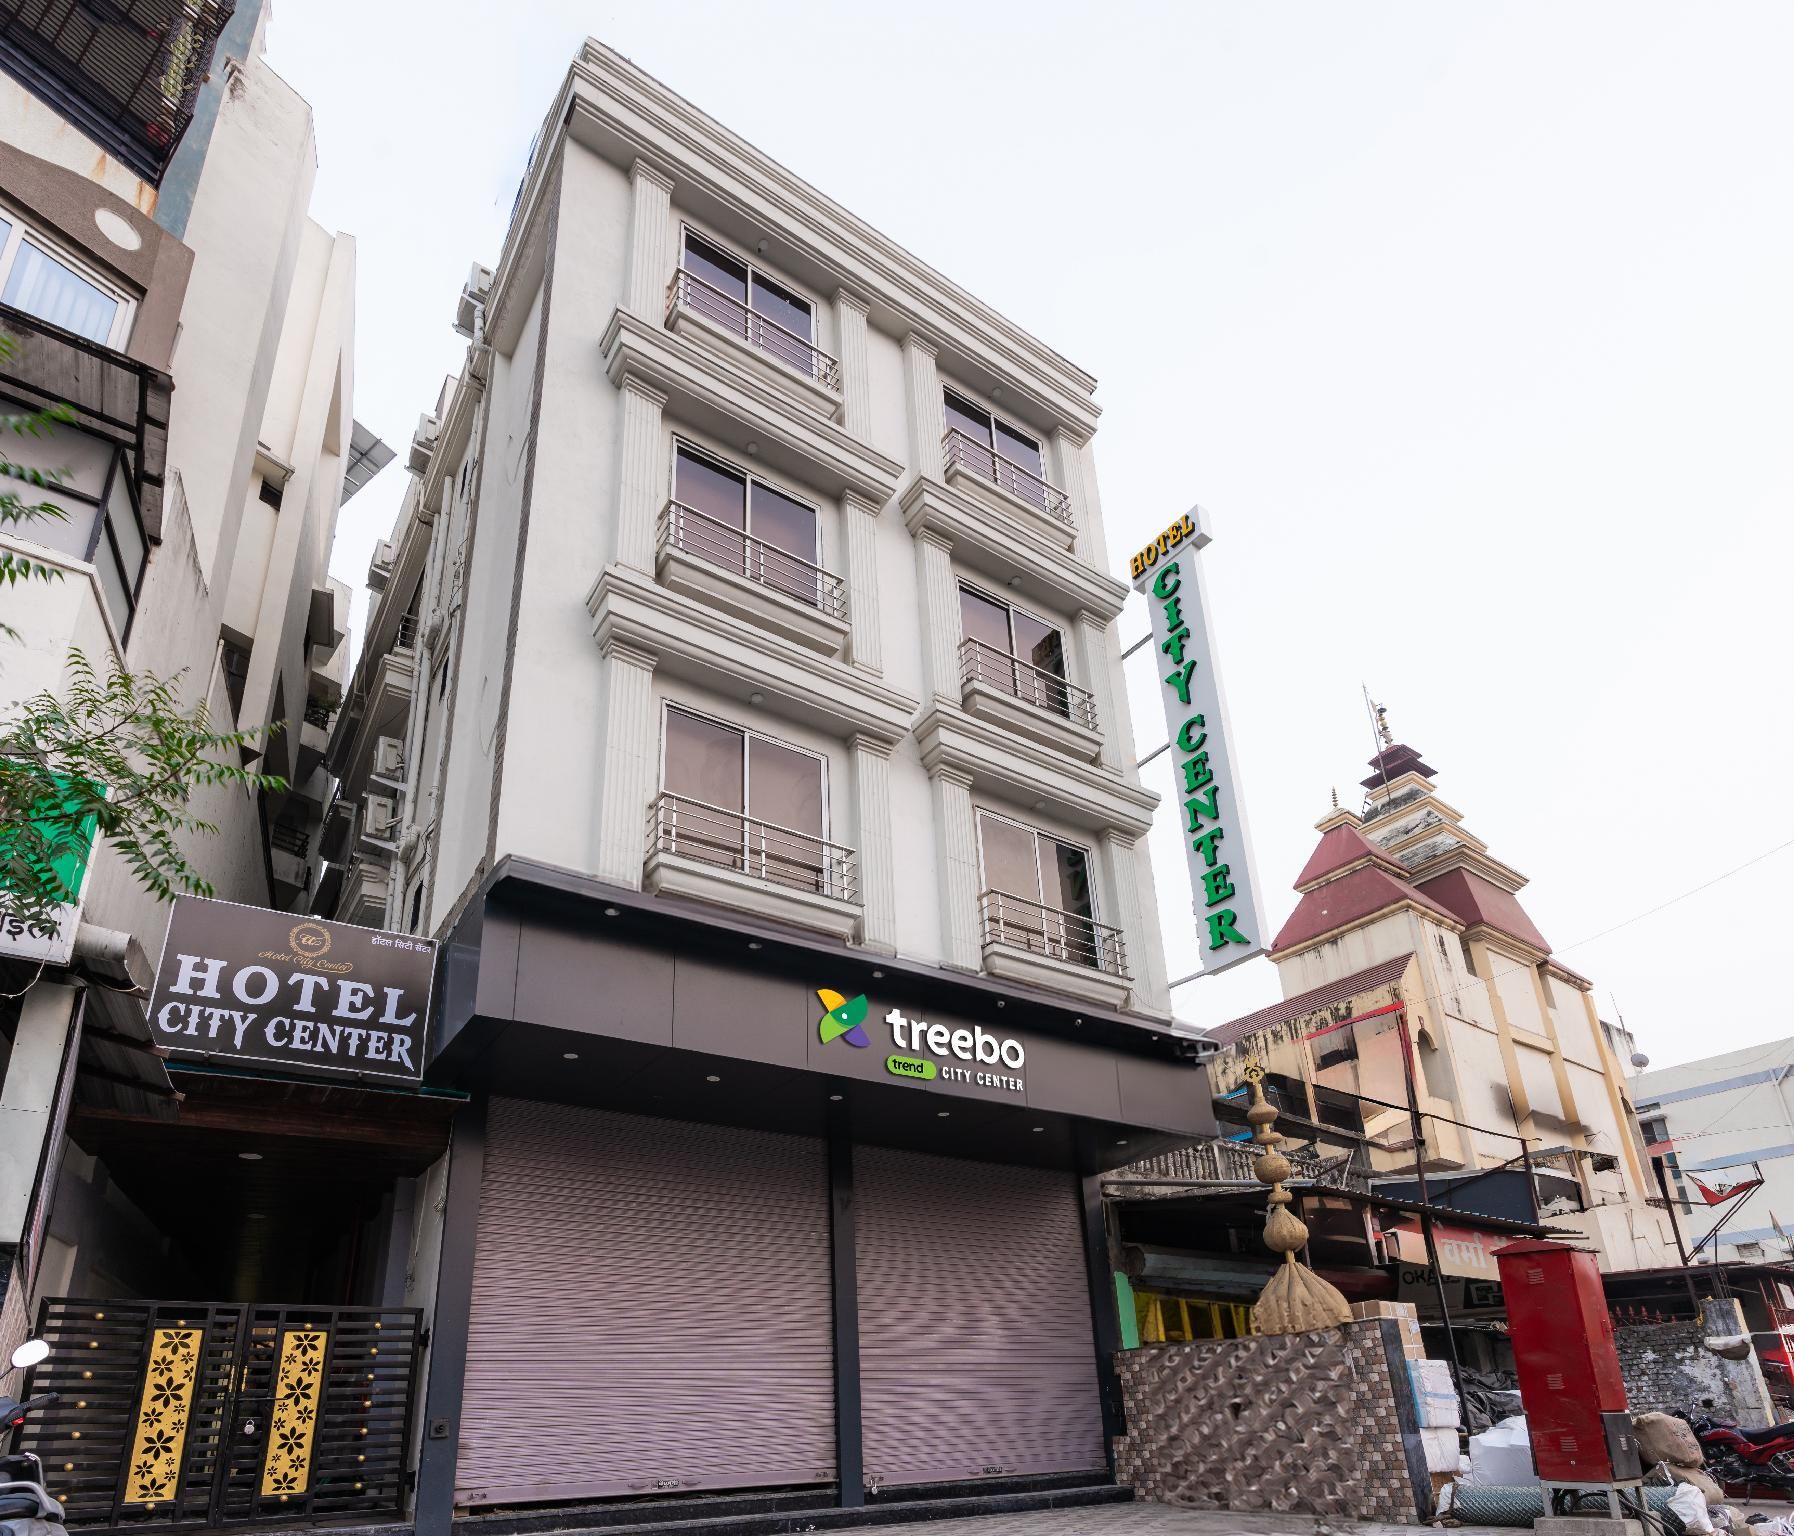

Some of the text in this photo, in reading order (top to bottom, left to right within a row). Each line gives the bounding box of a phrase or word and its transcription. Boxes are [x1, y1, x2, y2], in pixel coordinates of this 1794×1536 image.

[1130, 514, 1195, 580] HOTEL
[1152, 561, 1251, 951] CITY CENTER
[258, 950, 292, 962] Hotel
[169, 953, 417, 1027] HOTEL
[157, 1001, 414, 1072] CITY CENTER
[885, 1008, 1024, 1069] treebo
[892, 1058, 924, 1074] trend
[942, 1066, 1023, 1091] CITY CENTER
